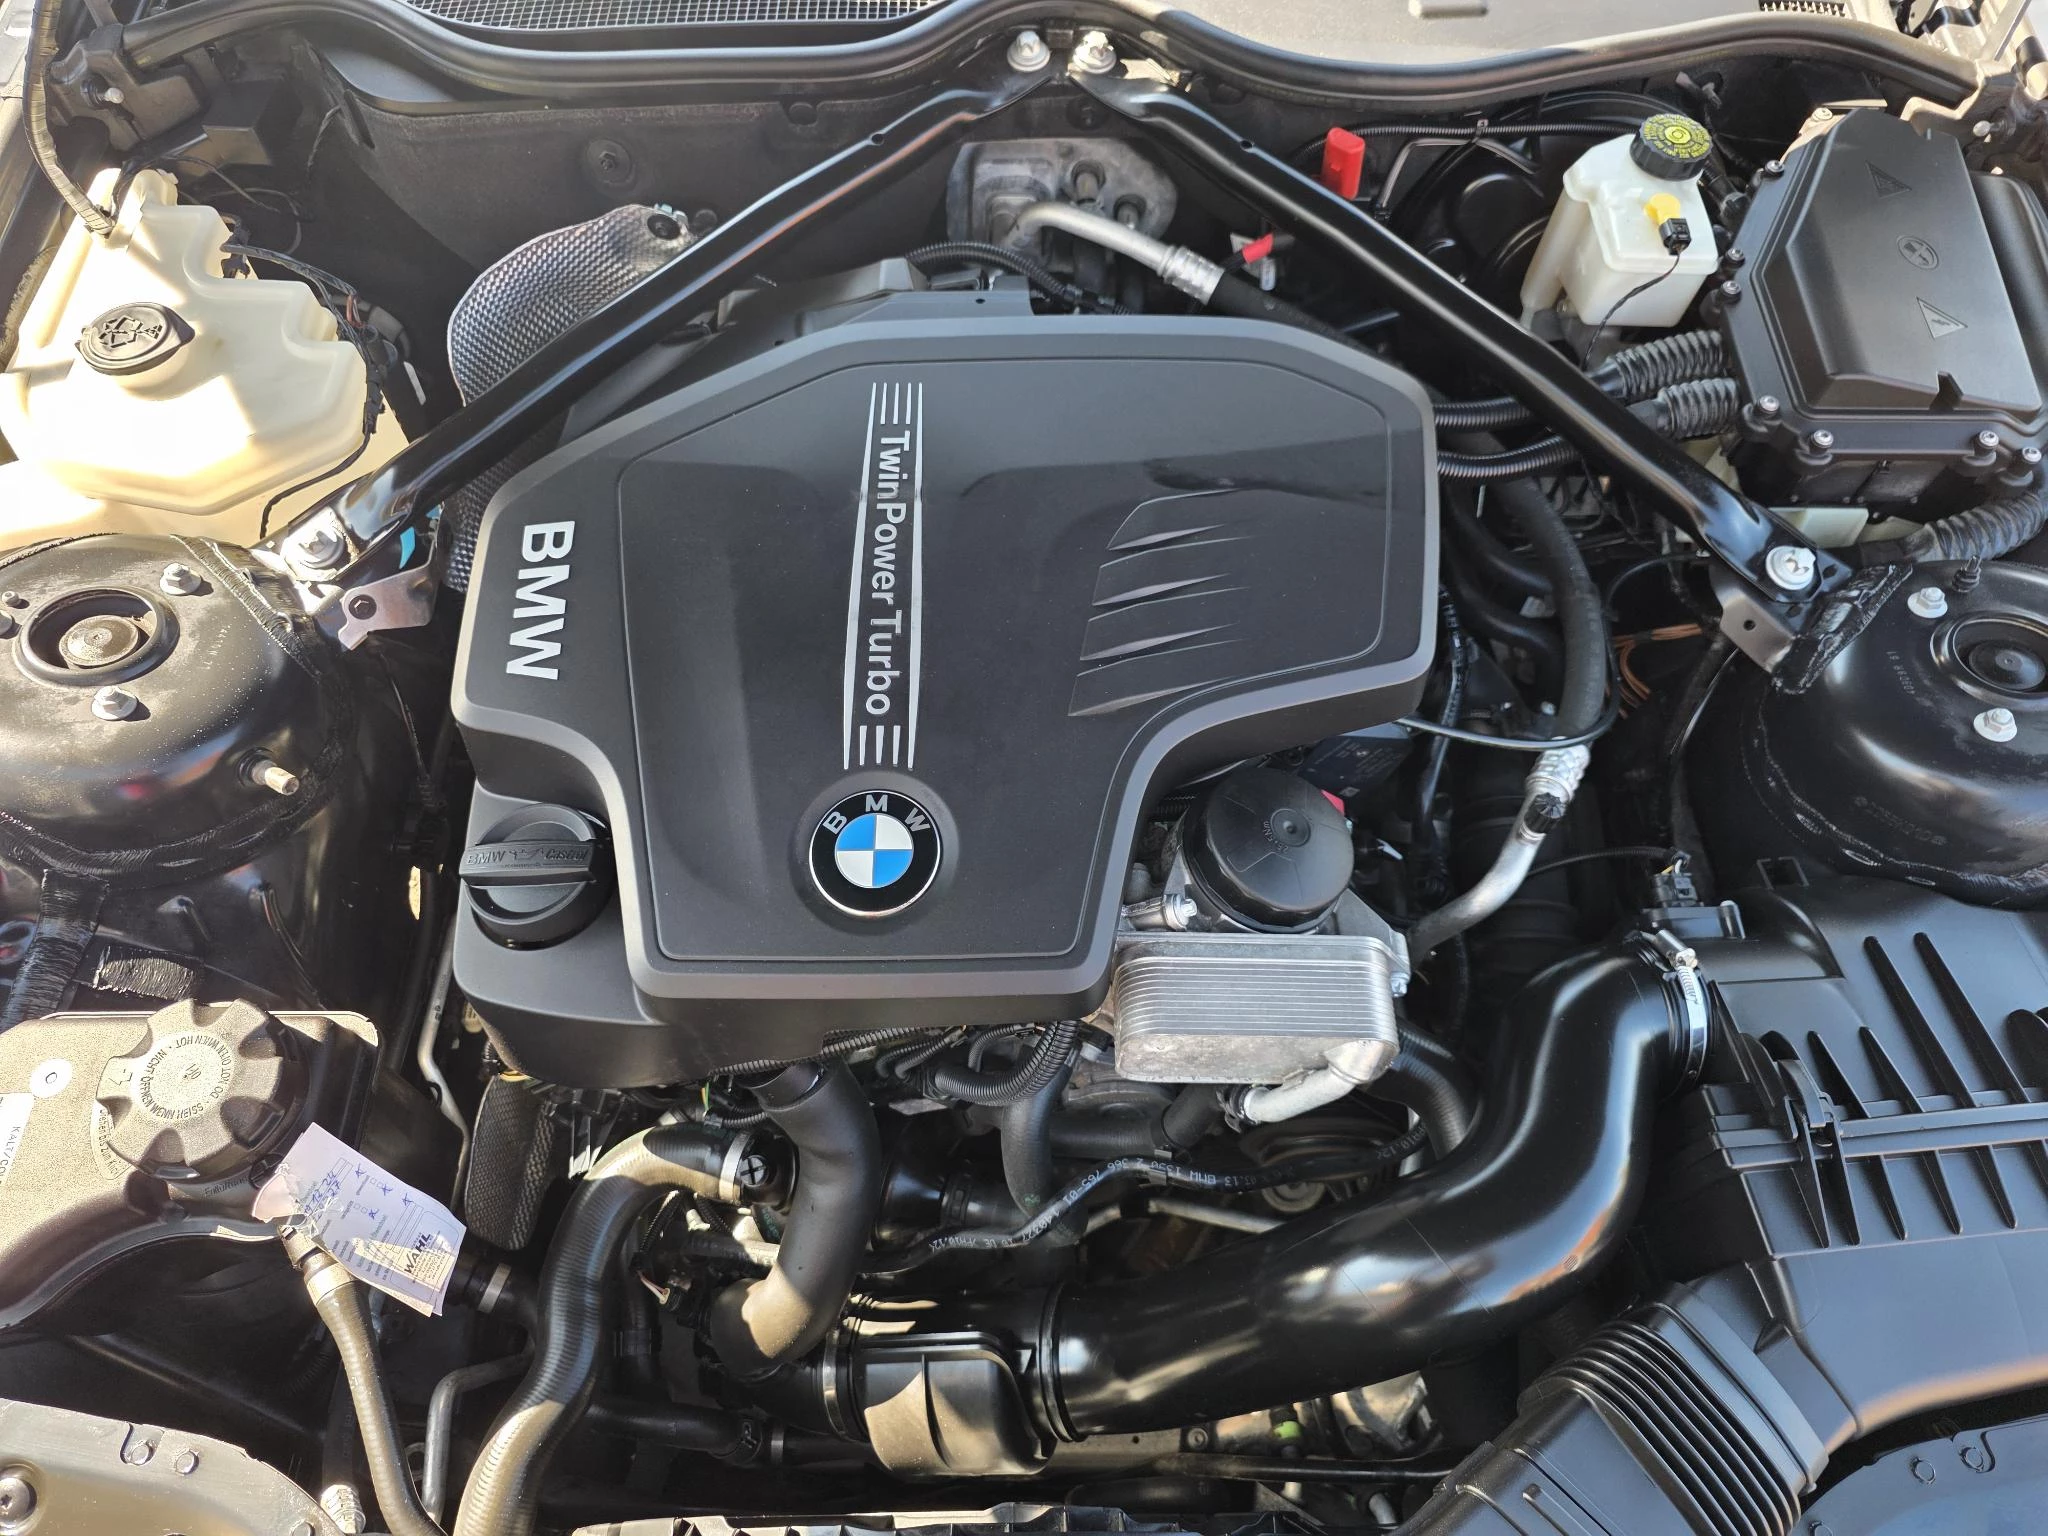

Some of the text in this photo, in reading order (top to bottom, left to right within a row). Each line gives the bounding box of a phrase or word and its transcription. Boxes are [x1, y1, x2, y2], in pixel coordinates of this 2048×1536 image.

[865, 430, 911, 715] TwinPower Turbo
[506, 520, 576, 680] BMW
[822, 794, 931, 834] BMW
[467, 851, 506, 865] BMW
[175, 1035, 193, 1048] HOT
[194, 1034, 219, 1049] WHEN
[145, 1048, 167, 1075] NICHT
[217, 1067, 230, 1084] NOT
[209, 1085, 223, 1098] DO
[149, 1102, 175, 1119] WENN
[176, 1102, 203, 1119] HEISS
[1107, 1157, 1130, 1171] 366
[1189, 1169, 1217, 1185] BMW
[1062, 1170, 1101, 1206] 765-01
[404, 1234, 430, 1272] WAHL
